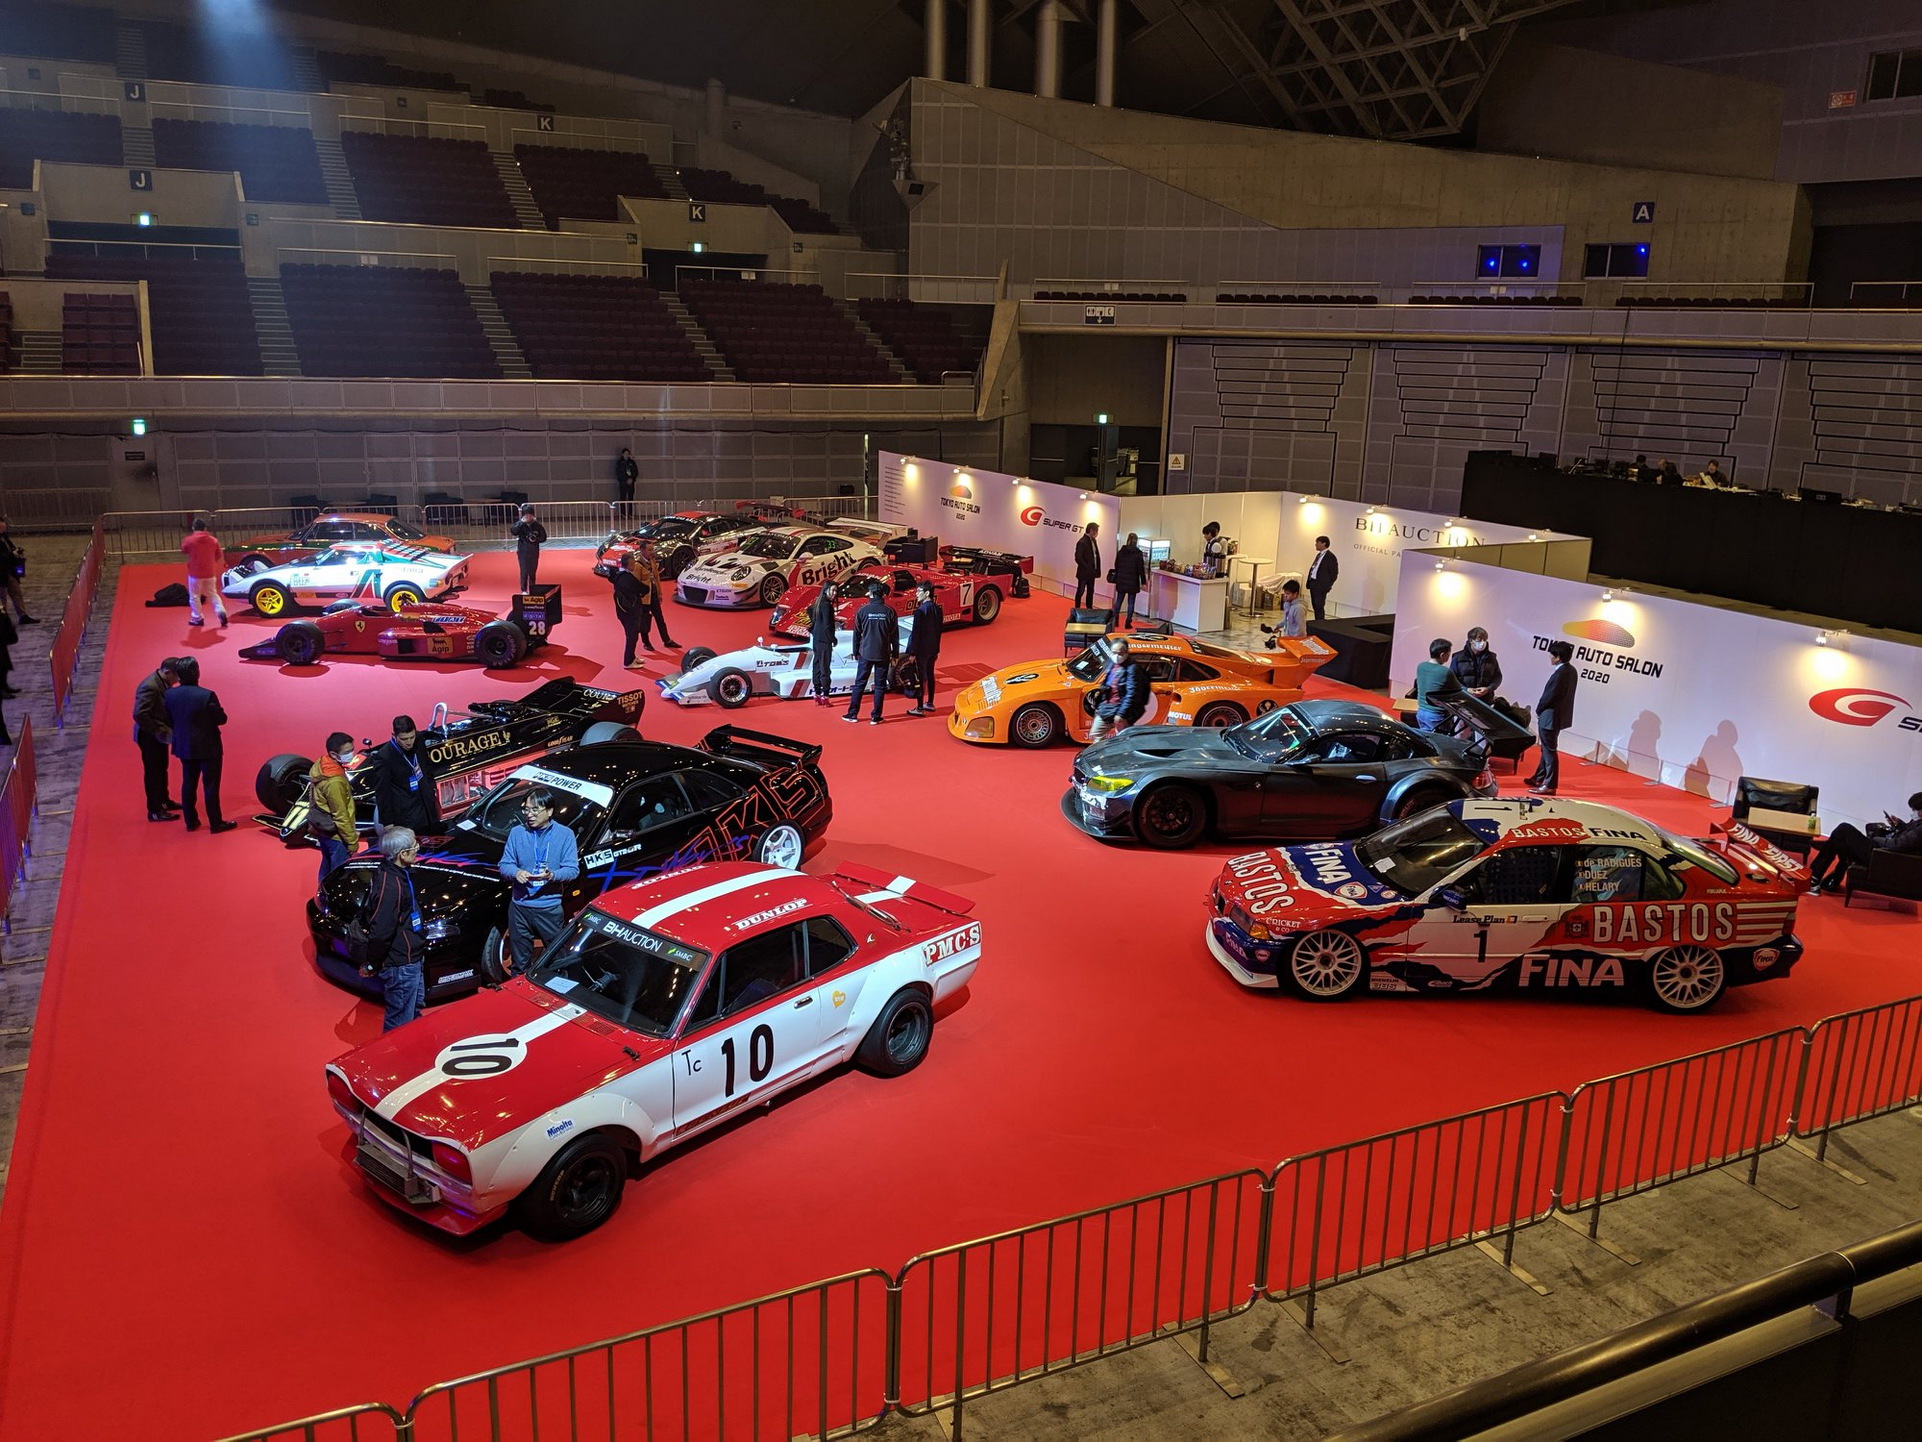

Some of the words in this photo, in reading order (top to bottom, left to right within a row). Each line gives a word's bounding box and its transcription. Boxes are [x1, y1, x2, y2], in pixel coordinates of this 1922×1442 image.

[129, 84, 140, 99] J
[540, 117, 552, 130] K
[135, 172, 146, 188] J
[692, 206, 704, 220] K
[1635, 204, 1650, 220] A
[1043, 517, 1073, 531] SUPER
[1072, 524, 1084, 534] GT
[827, 540, 836, 549] 33
[1353, 543, 1389, 556] OFFICIAL
[801, 551, 858, 586] Bright
[962, 583, 972, 606] 7
[529, 620, 545, 636] 28
[431, 645, 450, 654] Agip
[1576, 646, 1614, 666] AUTO
[1615, 655, 1663, 679] SALON
[1580, 668, 1611, 684] 2020
[617, 691, 643, 705] TISSOT
[1168, 711, 1193, 721] MOTUL
[429, 731, 502, 764] OURAGE
[550, 777, 583, 791] POWER
[1512, 827, 1586, 838] BASTOS
[1588, 827, 1647, 841] FINA
[585, 850, 612, 865] HKS
[1584, 859, 1595, 868] de
[1597, 858, 1642, 868] RADIGUES
[1305, 848, 1353, 885] FINA
[1227, 850, 1295, 915] BASTOS
[1584, 871, 1608, 880] DUEZ
[1585, 882, 1621, 892] HELARY
[735, 898, 808, 931] DUNLOP
[1452, 915, 1481, 925] Lease
[1481, 915, 1505, 925] Plan
[1593, 901, 1733, 943] BASTOS
[1265, 917, 1301, 929] CRICKET
[1473, 929, 1488, 963] 1
[673, 949, 693, 962] SMBC
[1518, 953, 1625, 987] FINA
[441, 1037, 520, 1076] 10
[681, 1049, 702, 1076] Tc
[720, 1023, 775, 1098] 10
[546, 1119, 573, 1138] Minolta
